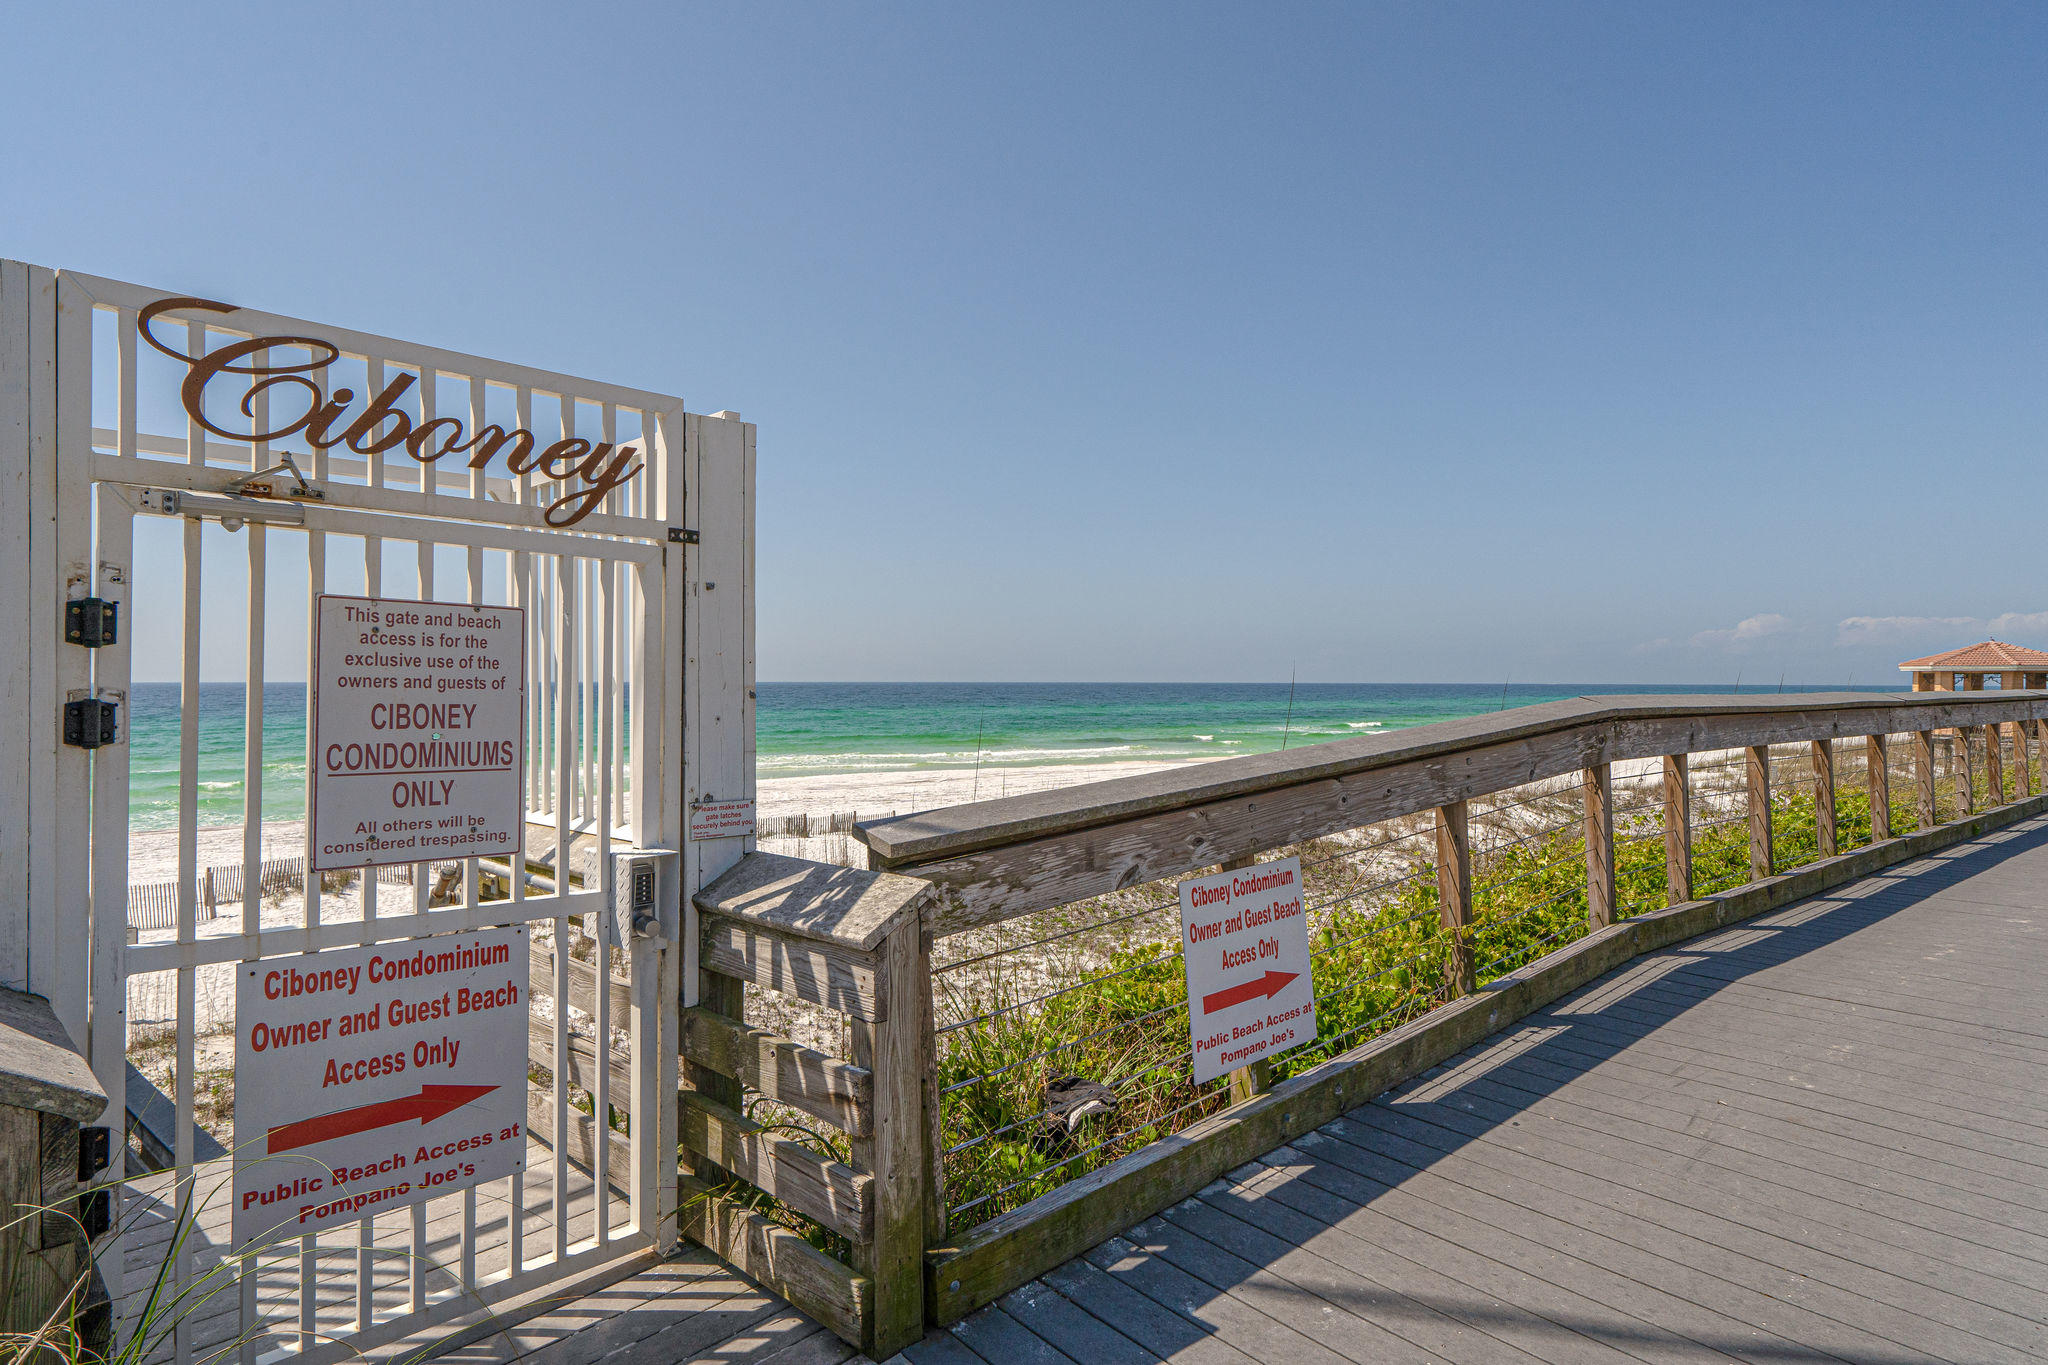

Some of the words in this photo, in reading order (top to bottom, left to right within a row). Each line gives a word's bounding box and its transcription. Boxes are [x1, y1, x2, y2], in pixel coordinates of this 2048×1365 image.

[137, 297, 644, 528] Ciboney
[345, 606, 380, 623] This
[385, 611, 419, 628] gate
[425, 613, 453, 626] and
[457, 614, 501, 629] beach
[360, 632, 416, 646] access
[421, 632, 435, 647] is
[439, 634, 461, 648] for
[465, 635, 488, 649] the
[344, 652, 422, 668] exclusive
[427, 656, 454, 669] use
[459, 655, 475, 669] of
[477, 656, 500, 670] the
[337, 676, 398, 688] owners
[403, 675, 432, 689] and
[437, 676, 487, 693] guests
[491, 676, 506, 690] of
[371, 703, 477, 730] CIBONEY
[326, 740, 514, 771] CONDOMINIUMS
[392, 780, 455, 808] ONLY
[323, 836, 416, 854] considered
[420, 830, 512, 847] trespassing.
[355, 821, 377, 834] All
[382, 819, 433, 833] others
[438, 815, 463, 828] will
[467, 815, 485, 826] be
[1191, 884, 1231, 908] Ciboney
[1233, 868, 1294, 897] Condominium
[1189, 920, 1222, 944] Owner
[1225, 911, 1243, 934] and
[1244, 904, 1272, 929] Guest
[1273, 896, 1301, 921] Beach
[264, 965, 361, 1000] Ciboney
[368, 941, 509, 984] Condominium
[1222, 946, 1257, 970] Access
[1258, 936, 1279, 959] Only
[251, 1016, 332, 1053] Owner
[339, 1003, 380, 1037] and
[388, 991, 451, 1028] Guest
[457, 980, 518, 1014] Beach
[1196, 1032, 1229, 1053] Public
[1232, 1019, 1263, 1040] Beach
[1266, 1007, 1300, 1028] Access
[1302, 1001, 1312, 1013] at
[322, 1051, 406, 1088] Access
[413, 1036, 461, 1068] Only
[1220, 1041, 1267, 1065] Pompano
[1270, 1028, 1295, 1046] Joe's
[242, 1177, 323, 1211] Public
[332, 1153, 407, 1187] Beach
[413, 1132, 493, 1164] Access
[499, 1122, 520, 1141] at
[299, 1180, 410, 1224] Pompano
[418, 1162, 476, 1190] Joe's
